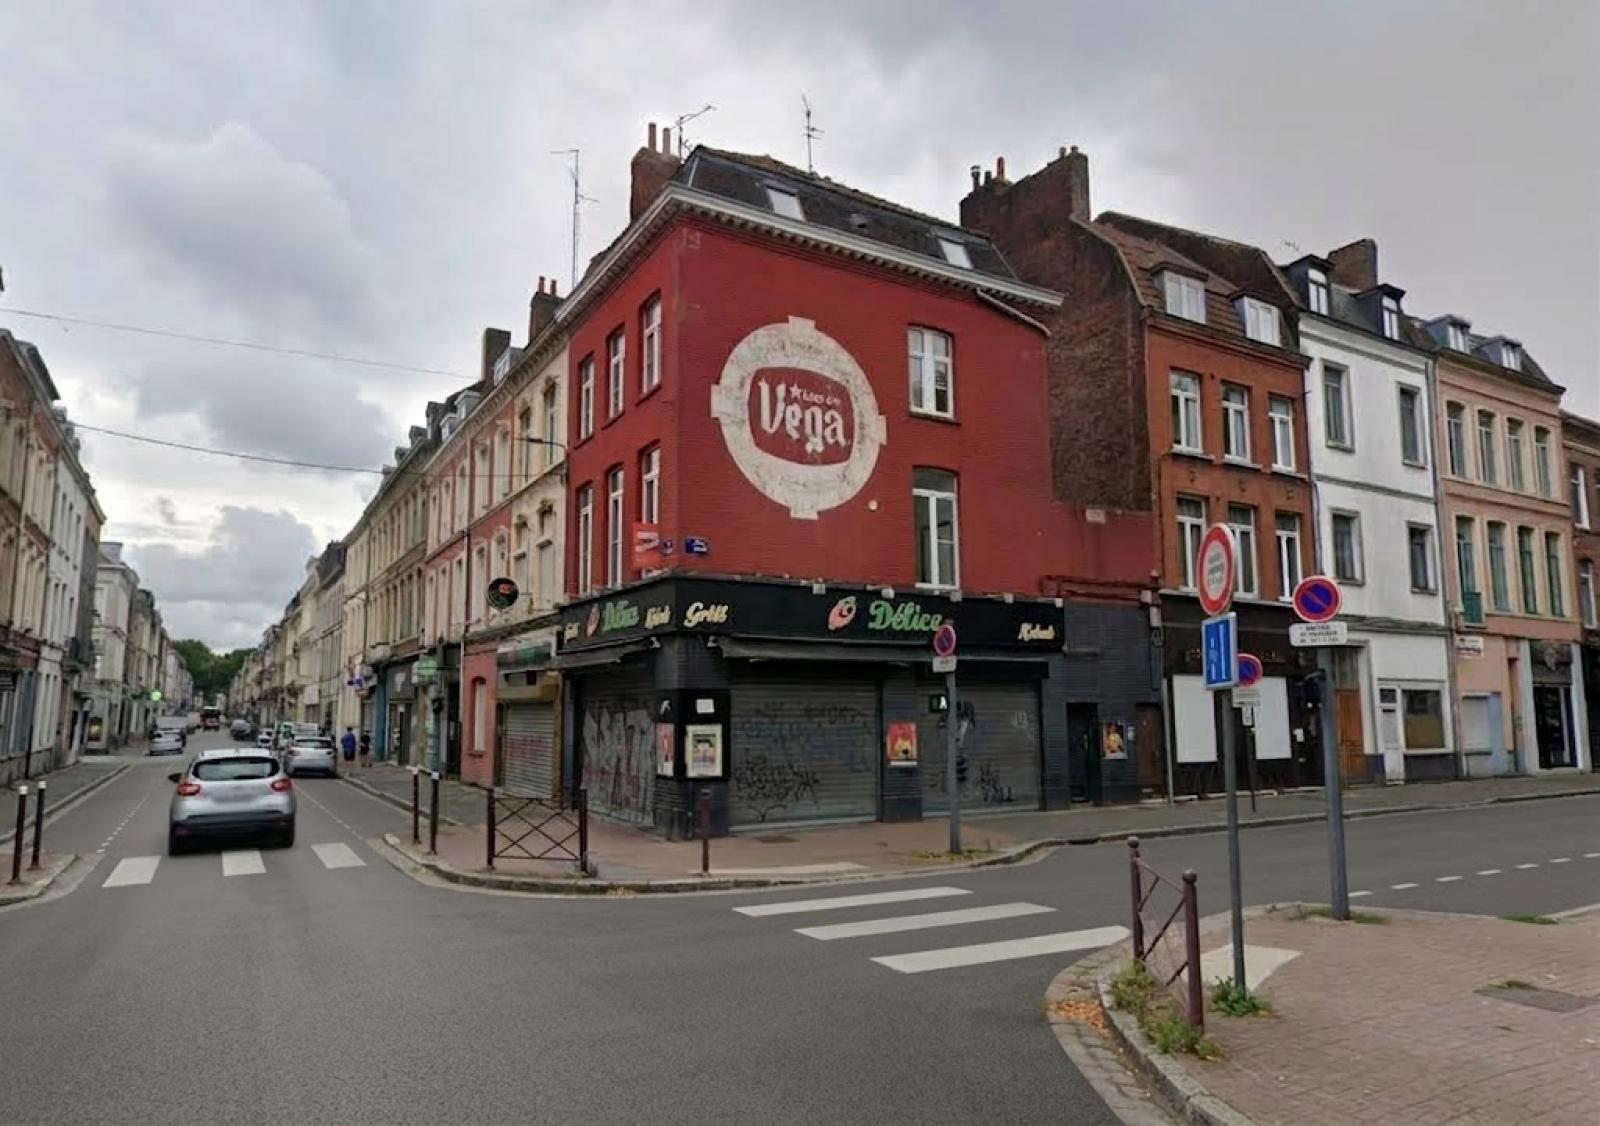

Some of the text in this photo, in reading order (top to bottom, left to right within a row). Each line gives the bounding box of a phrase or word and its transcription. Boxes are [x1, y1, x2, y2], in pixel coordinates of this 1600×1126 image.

[757, 377, 847, 454] Vega
[683, 602, 729, 628] Grill
[867, 600, 943, 632] Délice
